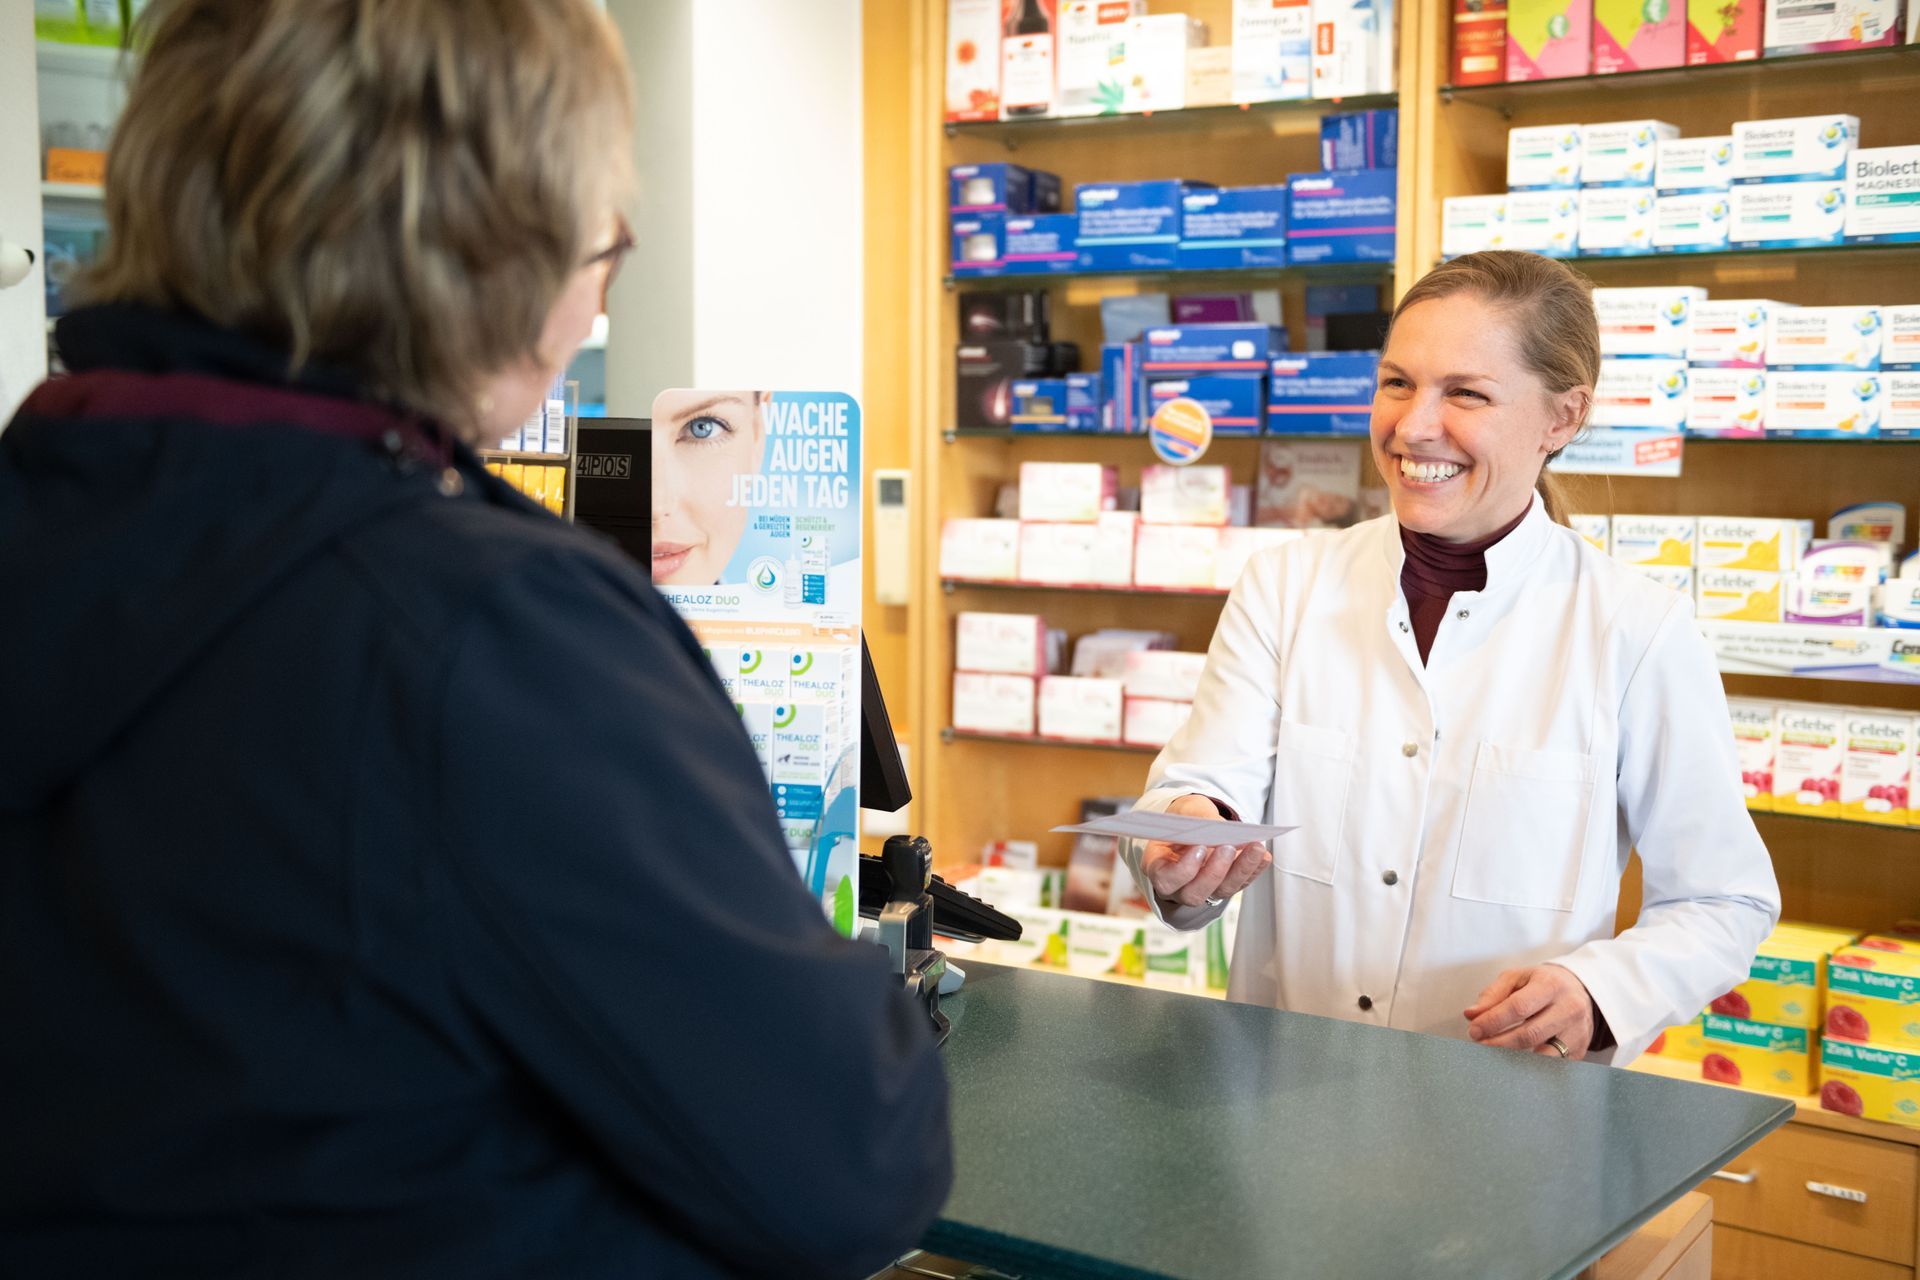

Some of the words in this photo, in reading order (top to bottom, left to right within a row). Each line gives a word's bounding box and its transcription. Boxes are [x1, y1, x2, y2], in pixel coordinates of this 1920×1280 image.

[760, 401, 849, 437] WACHE
[769, 438, 849, 473] AUGEN
[725, 473, 798, 508] JEDEN
[803, 474, 849, 509] TAG
[770, 530, 791, 539] AUGEN
[715, 595, 741, 606] DUO
[743, 679, 785, 689] THEALOZ
[793, 680, 836, 690] THEALOZ
[1781, 713, 1836, 732] Cetebe
[1848, 721, 1905, 739] Cetebe
[775, 732, 820, 743] THEALOZ
[1780, 959, 1792, 974] C
[1901, 977, 1915, 991] C
[1771, 1026, 1784, 1040] C
[1895, 1054, 1908, 1068] C
